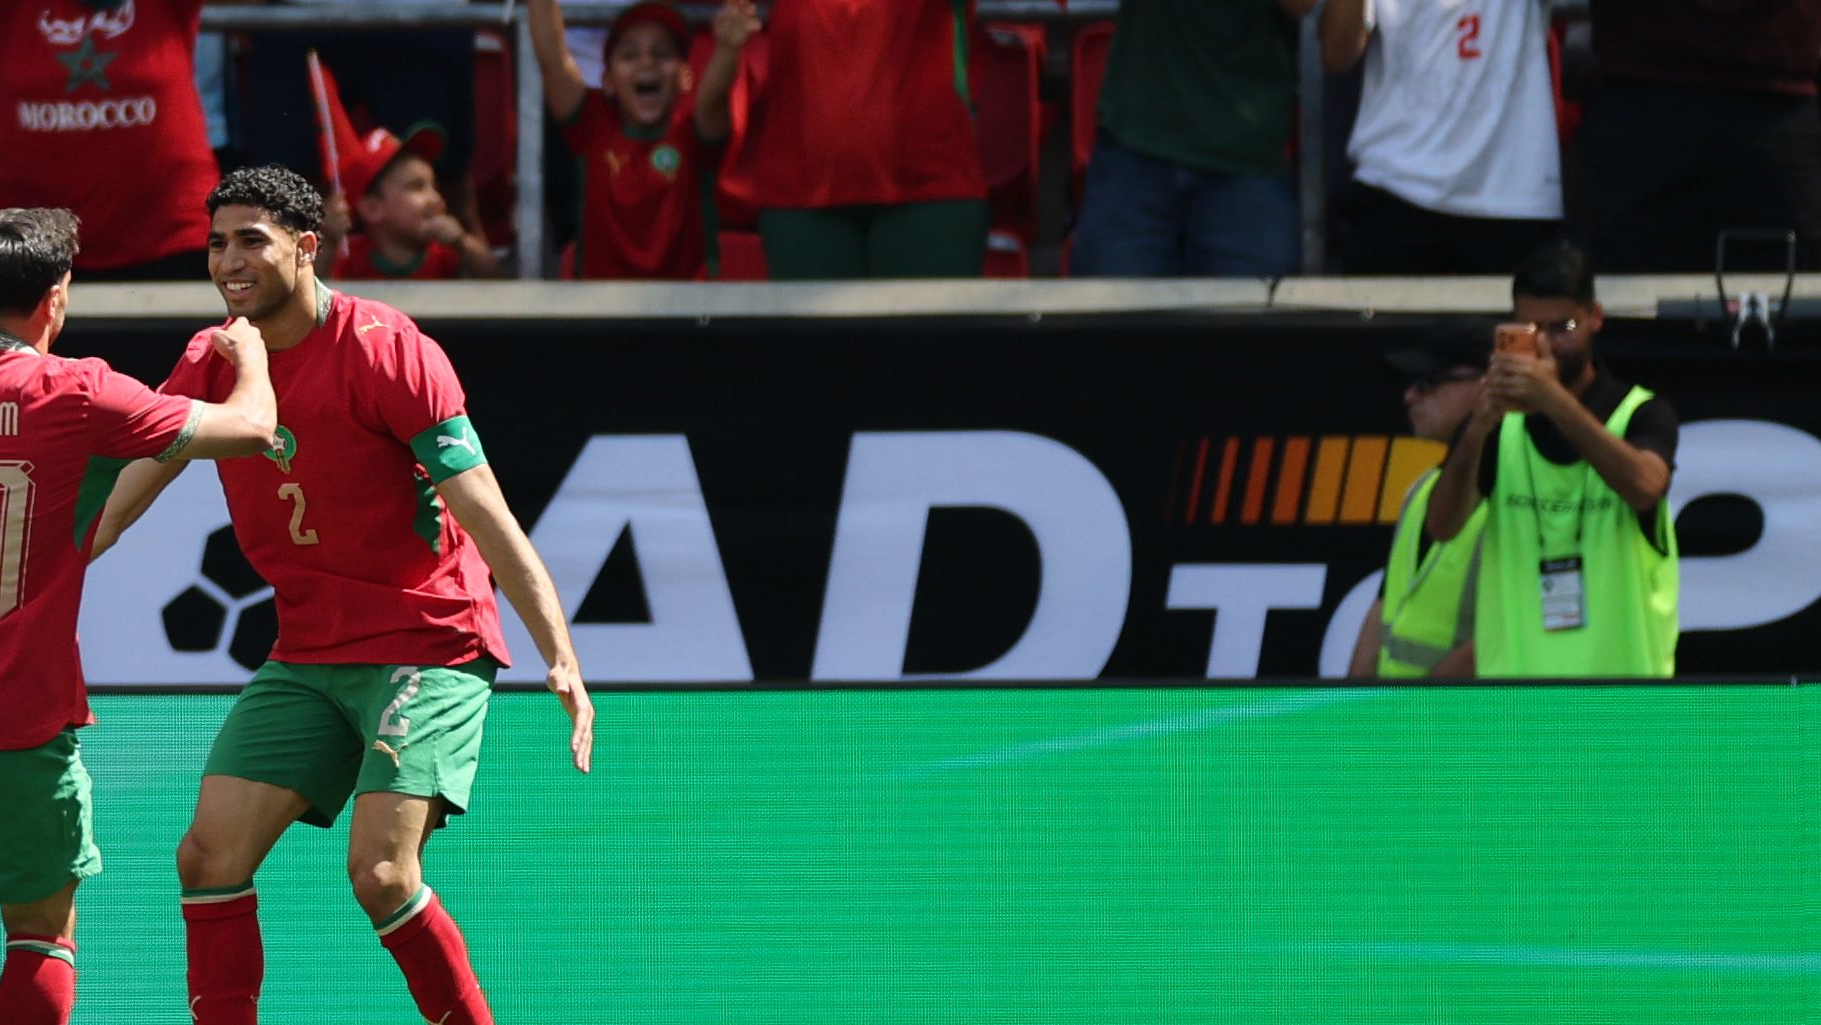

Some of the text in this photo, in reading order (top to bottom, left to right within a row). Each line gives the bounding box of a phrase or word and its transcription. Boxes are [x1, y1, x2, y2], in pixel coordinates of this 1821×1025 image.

[1456, 12, 1483, 60] 2
[16, 95, 157, 131] MOROCCO
[277, 482, 320, 546] 2
[378, 664, 422, 737] 2
